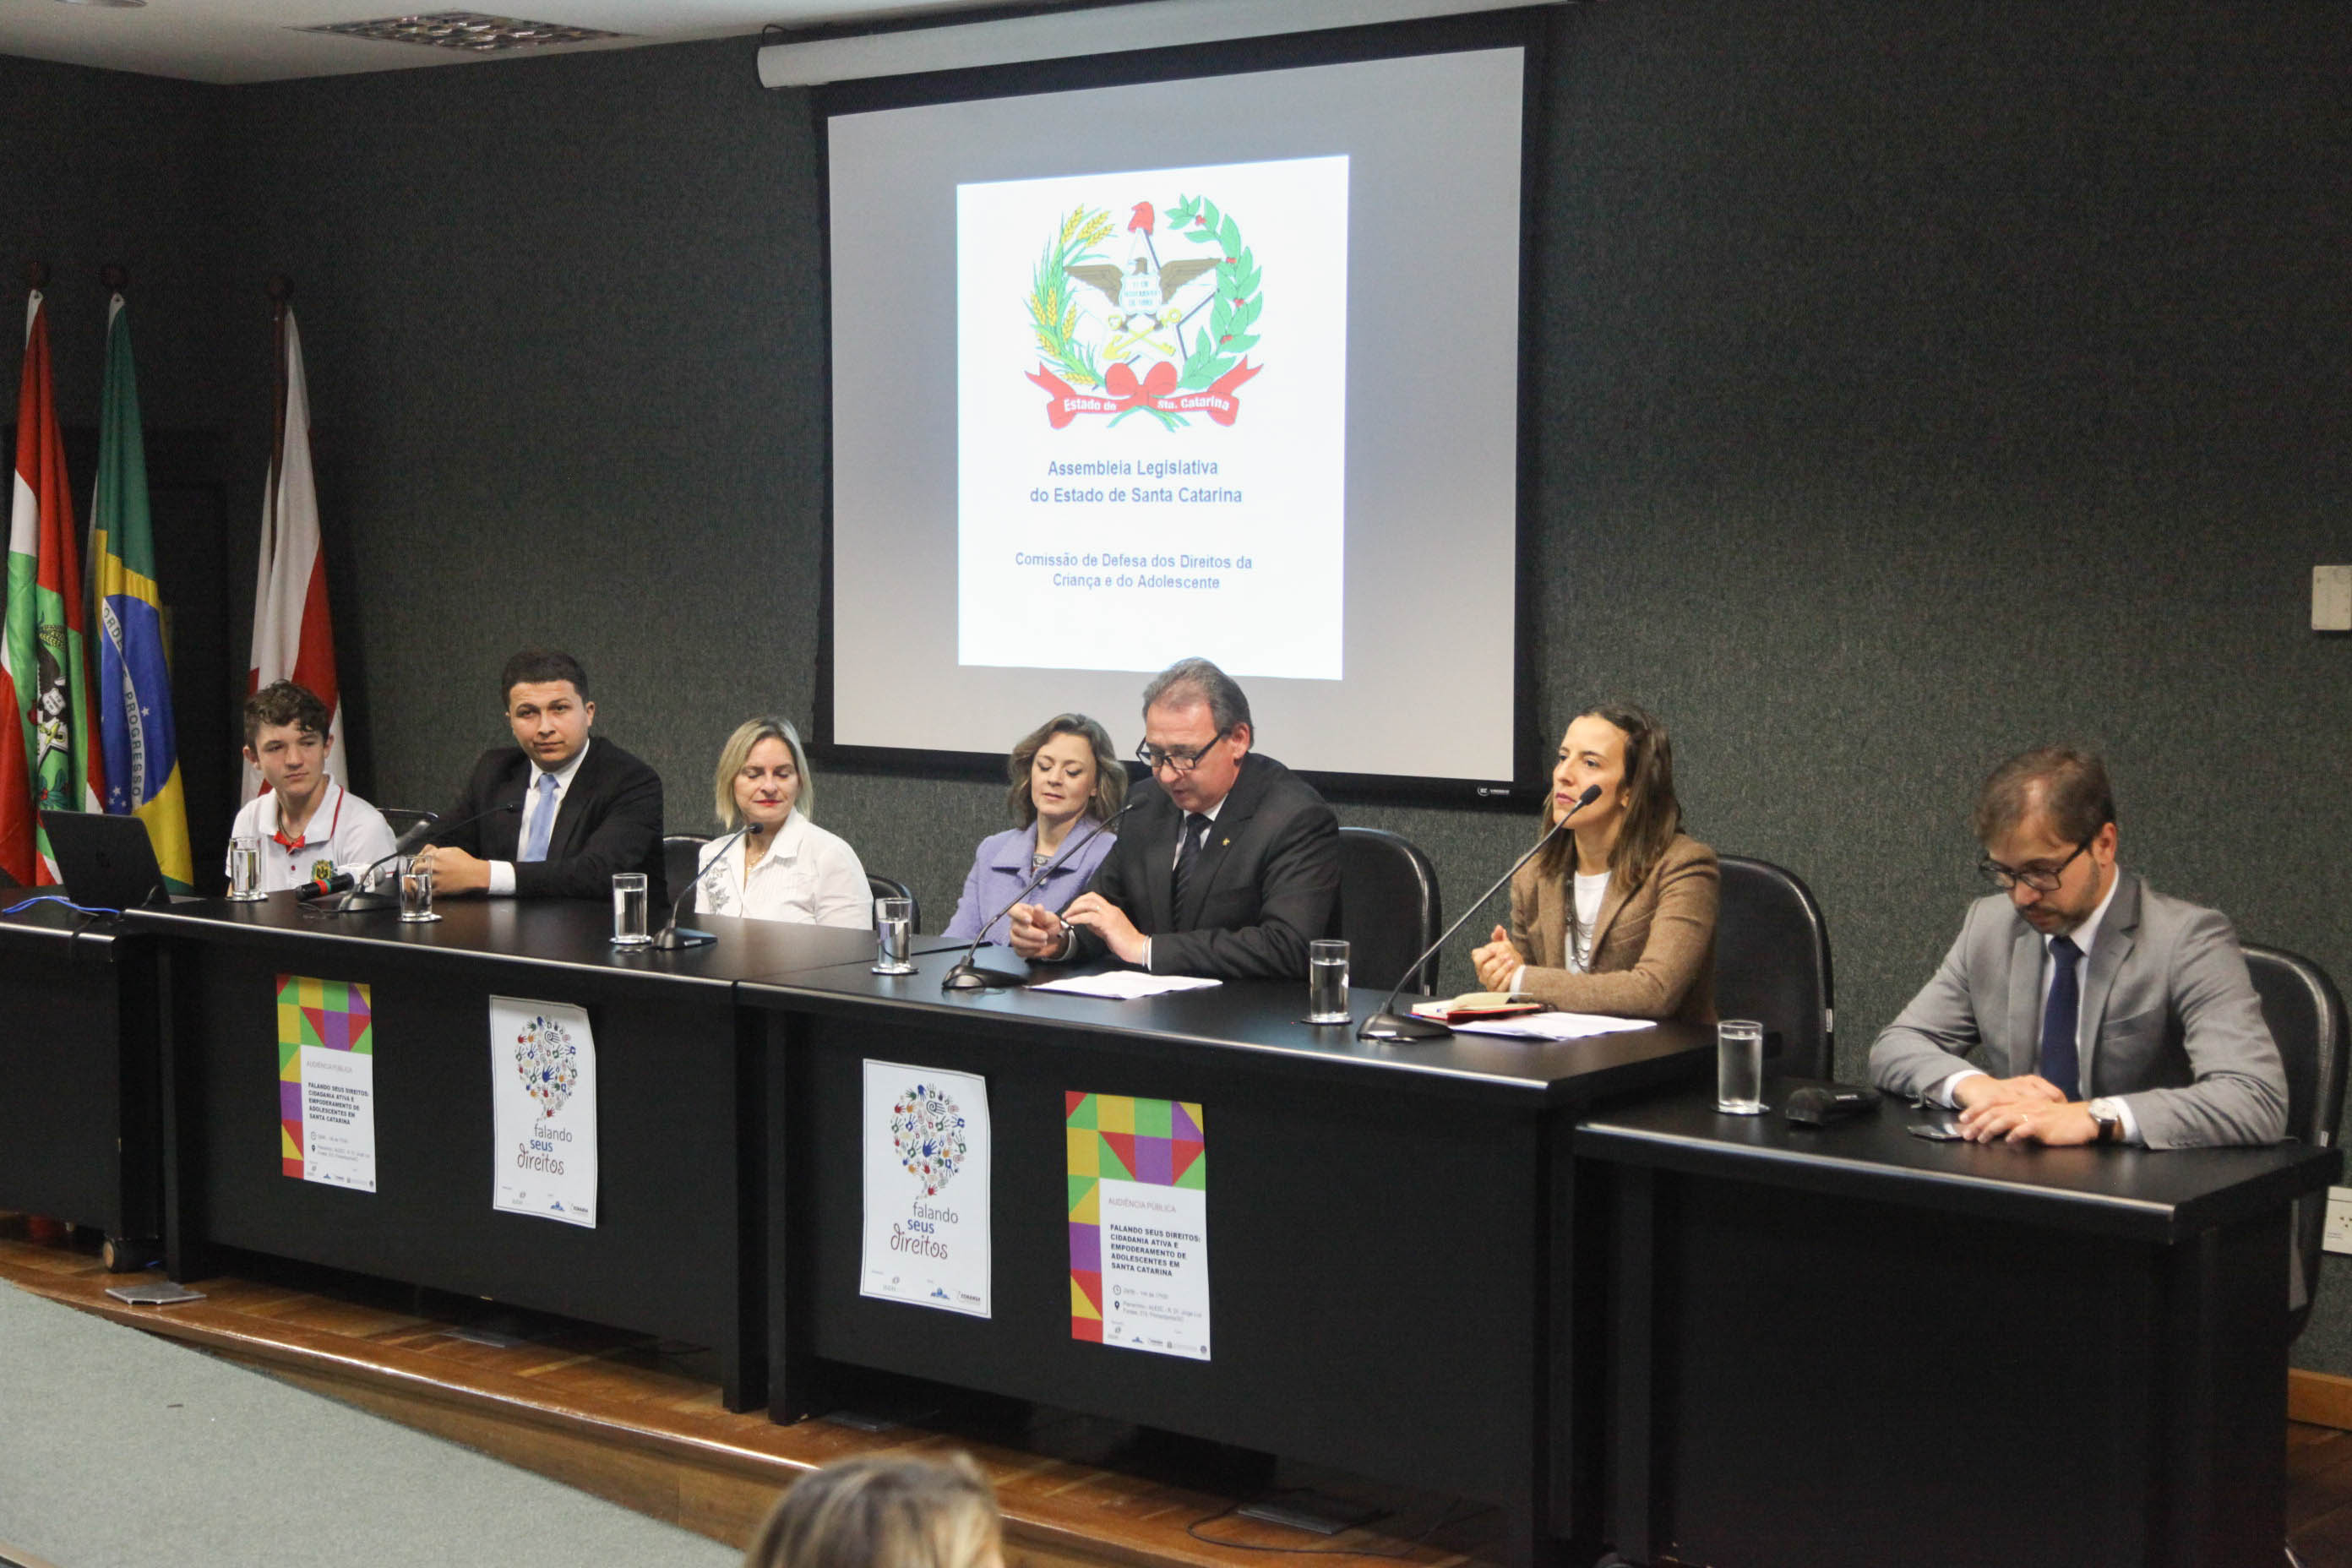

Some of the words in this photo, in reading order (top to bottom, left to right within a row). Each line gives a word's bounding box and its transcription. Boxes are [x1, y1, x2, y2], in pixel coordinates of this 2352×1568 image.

[1064, 399, 1101, 412] Estado
[1157, 400, 1178, 409] Sta.
[1181, 396, 1229, 411] Catarina
[1048, 460, 1131, 476] Assembleia
[1137, 460, 1218, 479] Legislativa
[1030, 487, 1049, 502] do
[1054, 487, 1103, 503] Estado
[1108, 487, 1126, 502] de
[1132, 487, 1173, 503] Santa
[1179, 487, 1243, 503] Catarina
[1015, 552, 1078, 567] Comissão
[1082, 553, 1097, 567] de
[1102, 553, 1147, 568] Defesa
[1152, 554, 1175, 568] dos
[1180, 554, 1231, 569] Direitos
[1236, 556, 1252, 569] da
[1053, 573, 1101, 590] Criança
[1105, 577, 1112, 587] e
[1117, 574, 1133, 587] do
[1137, 574, 1220, 589] Adolescente
[126, 691, 142, 797] PROGRESSO
[308, 1082, 330, 1091] FALANDO
[309, 1105, 346, 1116] ADOLESCENTES
[326, 1116, 350, 1124] CATARINA
[534, 1123, 572, 1142] falando
[530, 1139, 553, 1152] seus
[517, 1142, 564, 1175] direitos
[912, 1201, 958, 1223] falando
[907, 1218, 934, 1234] seus
[1110, 1224, 1143, 1234] FALANDO
[1145, 1228, 1163, 1237] SEUS
[890, 1222, 948, 1260] direitos
[1111, 1233, 1149, 1244] CIDADANIA
[1152, 1239, 1172, 1248] ATIVA
[1111, 1244, 1175, 1258] EMPODERAMENTO
[1111, 1253, 1167, 1266] ADOLESCENTES
[1112, 1262, 1135, 1271] SANTA
[1137, 1266, 1173, 1277] CATARINA
